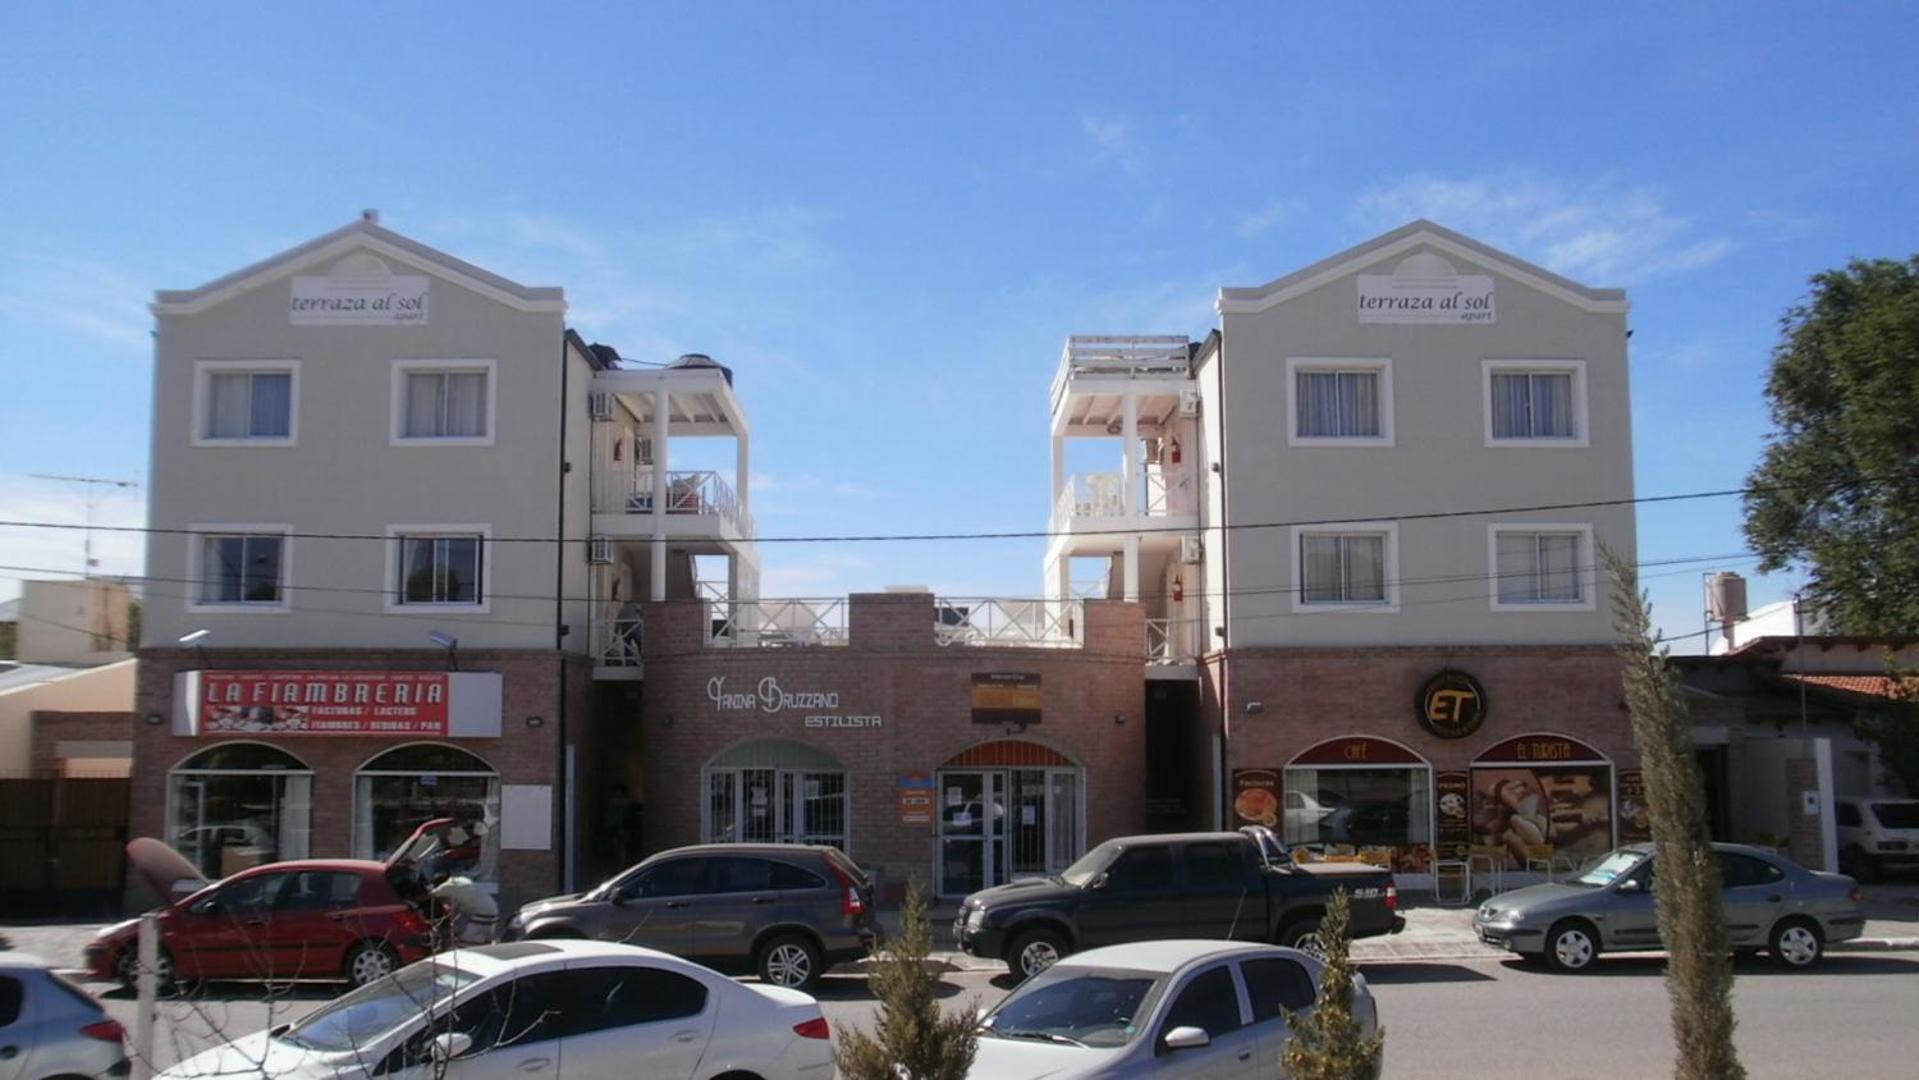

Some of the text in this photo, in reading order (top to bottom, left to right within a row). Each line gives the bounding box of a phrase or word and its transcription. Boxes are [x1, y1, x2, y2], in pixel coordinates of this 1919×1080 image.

[292, 292, 429, 310] terraza al sol
[1359, 291, 1494, 310] terraza al sol
[1461, 311, 1492, 321] apart
[207, 682, 442, 703] LA FIAMBRERIA
[1430, 689, 1474, 721] ET
[805, 715, 882, 727] ESTILISTA
[1532, 743, 1571, 759] TURISTA
